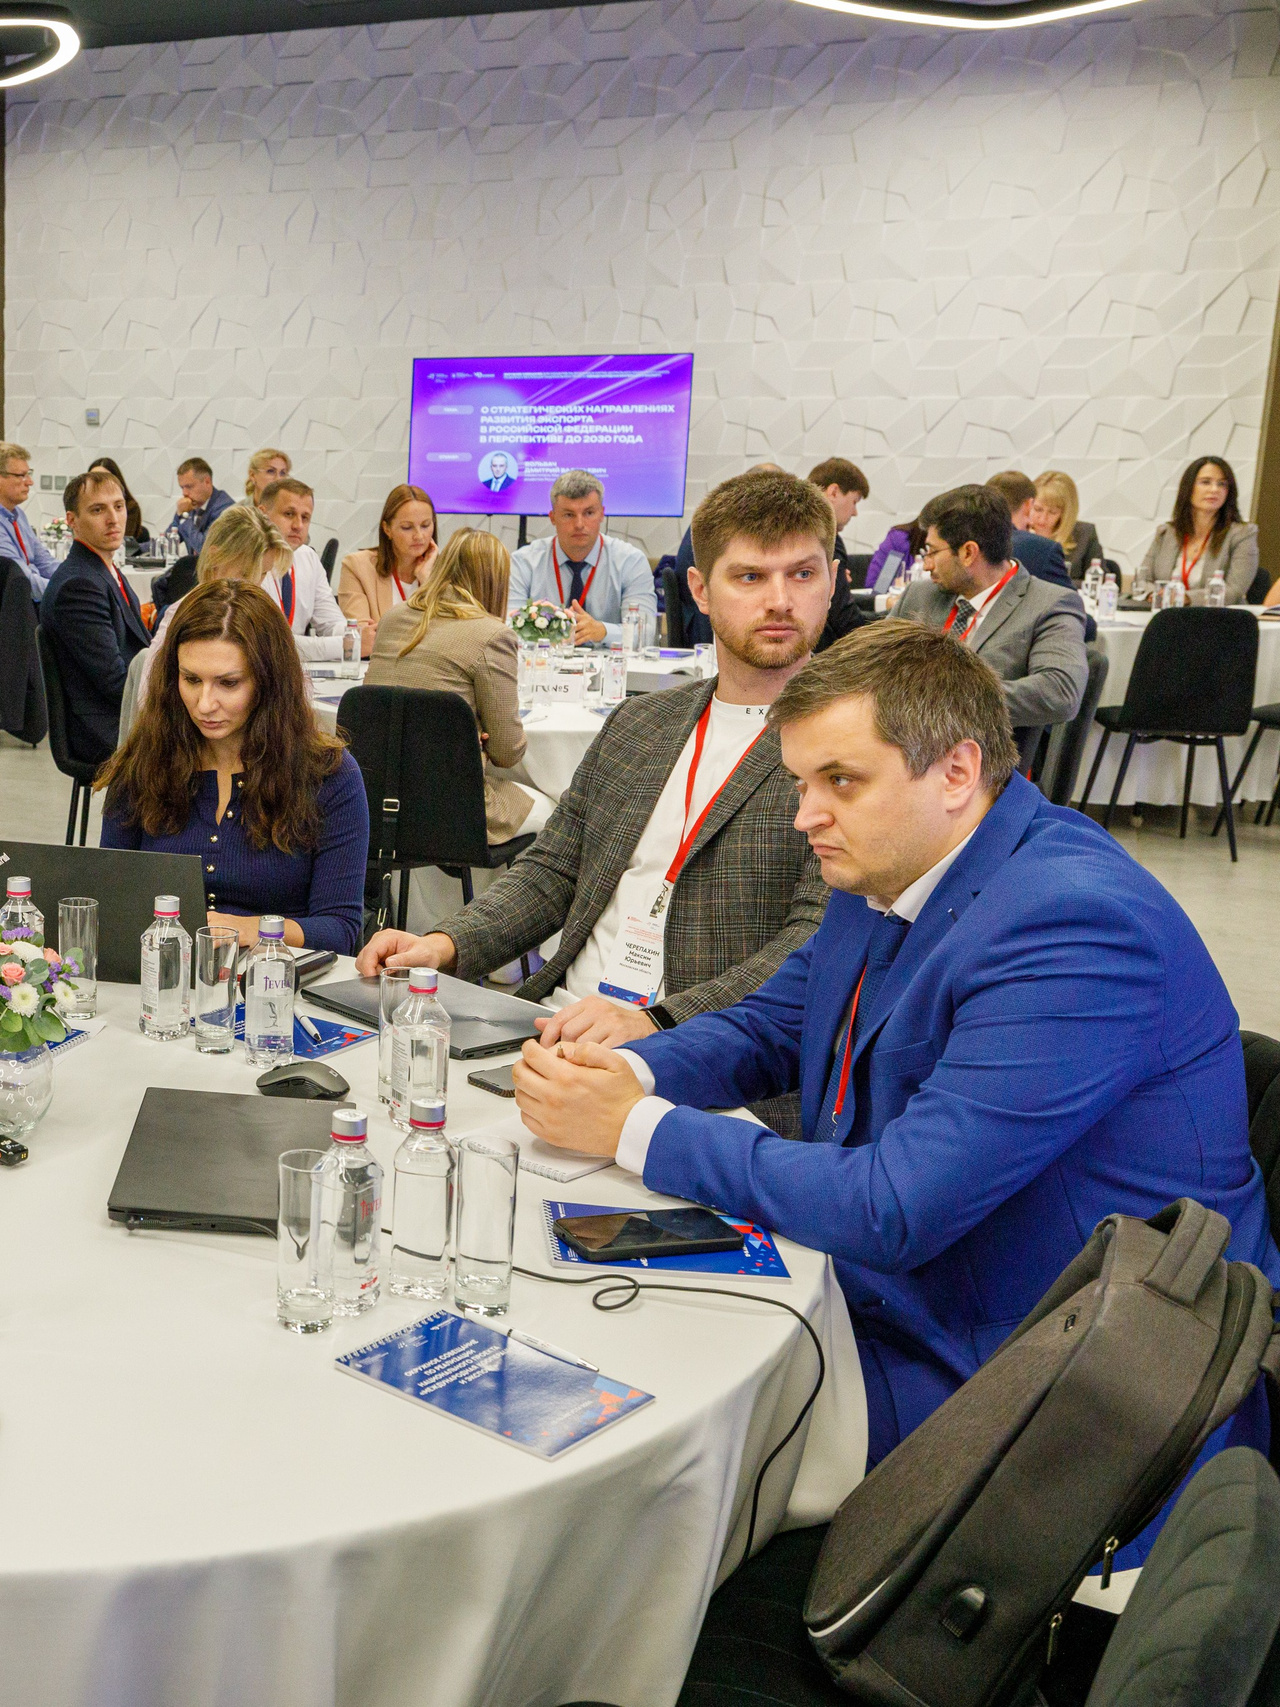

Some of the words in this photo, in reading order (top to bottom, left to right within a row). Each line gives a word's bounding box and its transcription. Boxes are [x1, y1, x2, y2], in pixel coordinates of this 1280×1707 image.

[481, 406, 489, 414] О
[491, 405, 585, 414] СТРАТЕГИЧЕСКИХ
[586, 404, 675, 413] НАПРАВЛЕНИЯХ
[480, 416, 536, 424] РАЗВИТИЯ
[537, 415, 594, 424] ЭКСПОРТА
[480, 425, 487, 433] В
[489, 424, 562, 433] РОССИЙСКОЙ
[564, 425, 633, 434] ФЕДЕРАЦИИ
[480, 435, 487, 443] В
[489, 435, 563, 443] ПЕРСПЕКТИВЕ
[565, 435, 582, 444] ДО
[583, 435, 612, 443] 2030
[613, 435, 643, 444] ГОДА
[625, 942, 660, 956] ЧЕРЕПАХИН
[629, 951, 651, 961] Максим
[624, 956, 651, 968] Юрьевич
